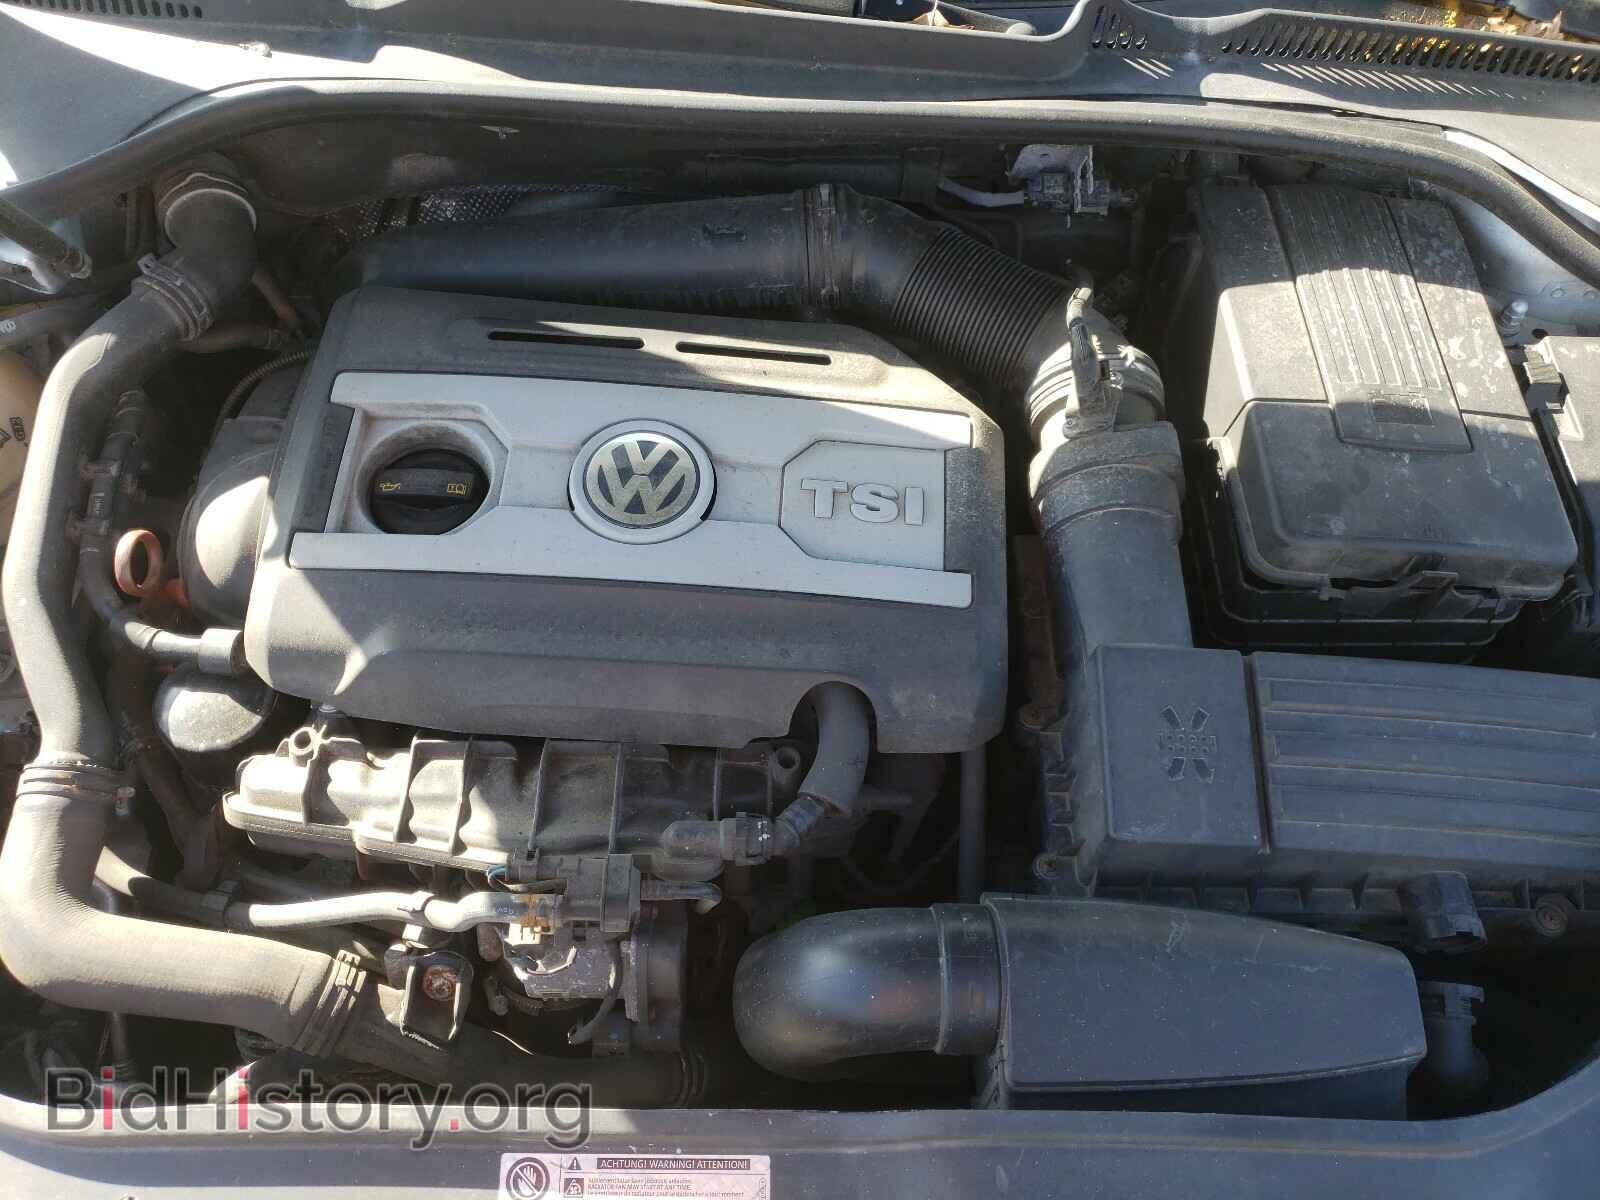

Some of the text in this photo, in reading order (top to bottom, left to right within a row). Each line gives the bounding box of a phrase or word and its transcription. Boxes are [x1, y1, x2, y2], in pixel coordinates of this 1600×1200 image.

[800, 478, 925, 527] TSI
[600, 1159, 748, 1170] ACHTUNG! WARNING! ATTENTION!
